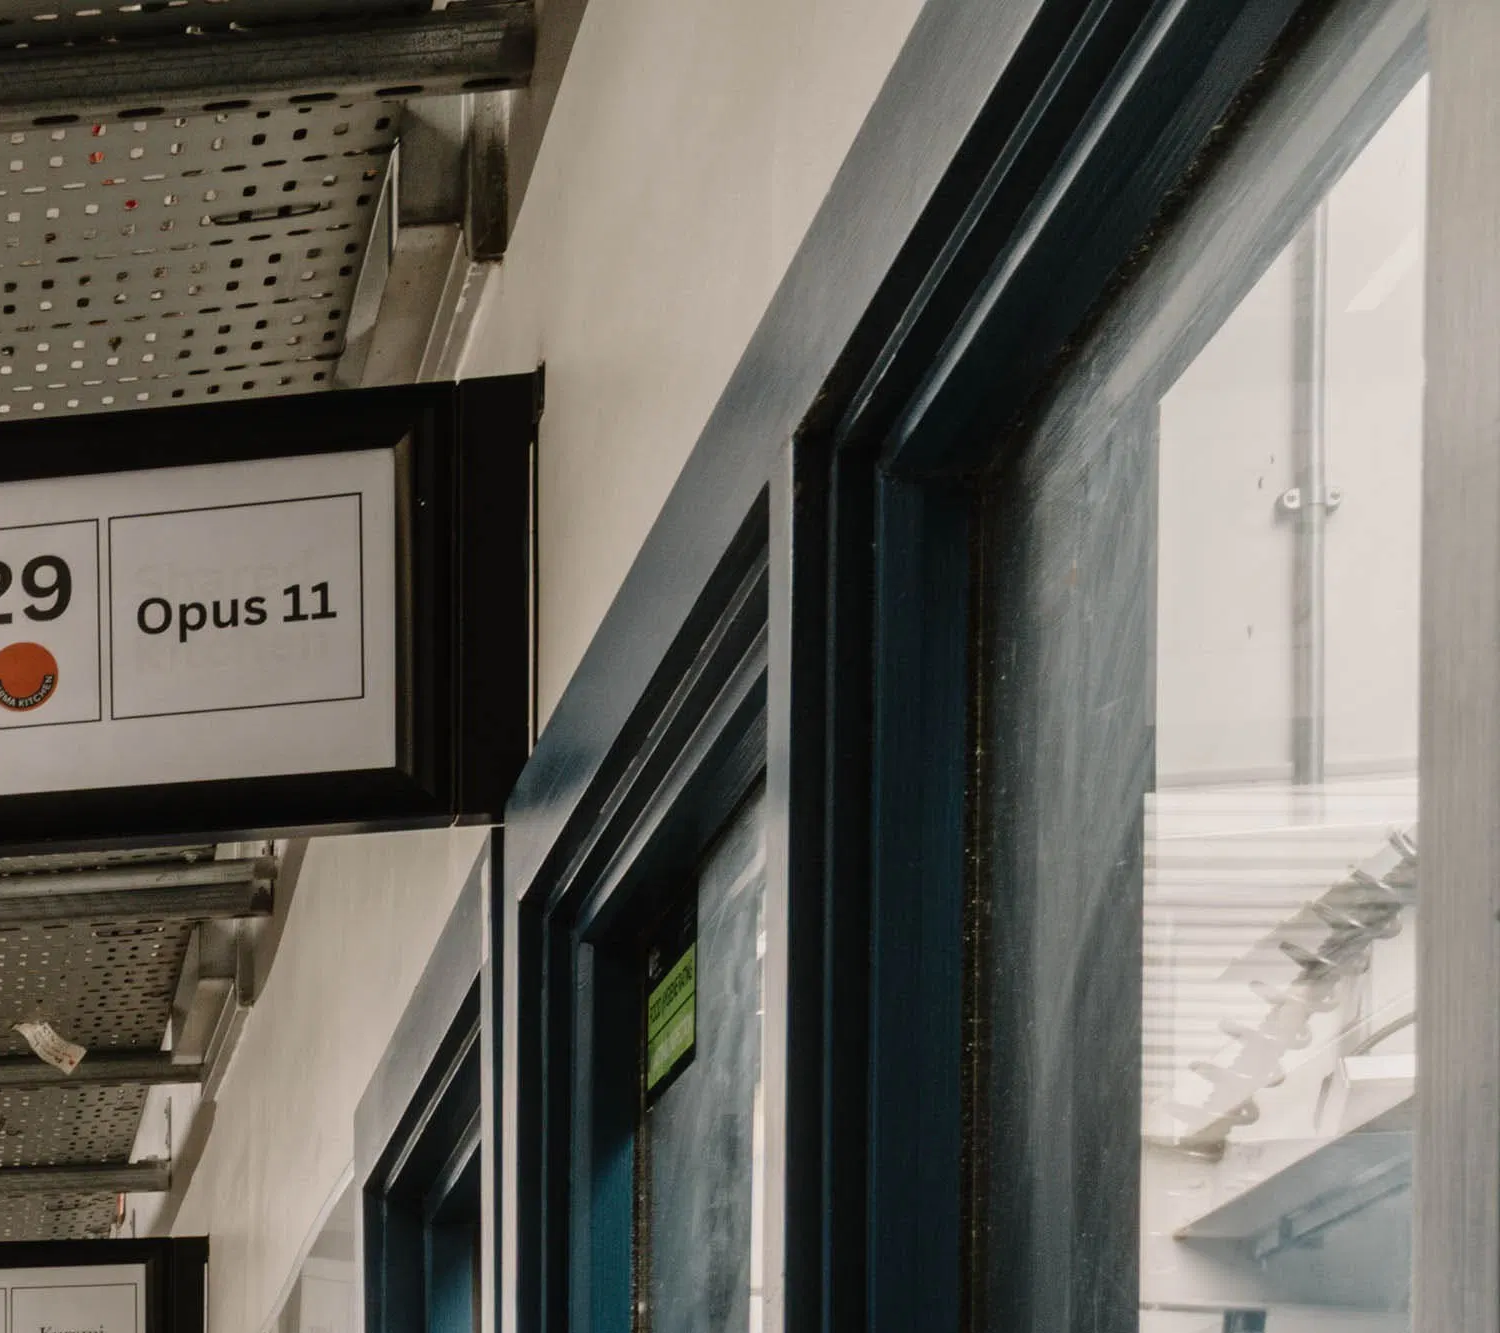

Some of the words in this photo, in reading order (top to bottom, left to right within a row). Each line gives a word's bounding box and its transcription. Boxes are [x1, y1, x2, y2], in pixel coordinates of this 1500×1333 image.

[136, 595, 268, 642] Opus
[283, 581, 337, 622] 11
[18, 675, 54, 707] KITCHEN
